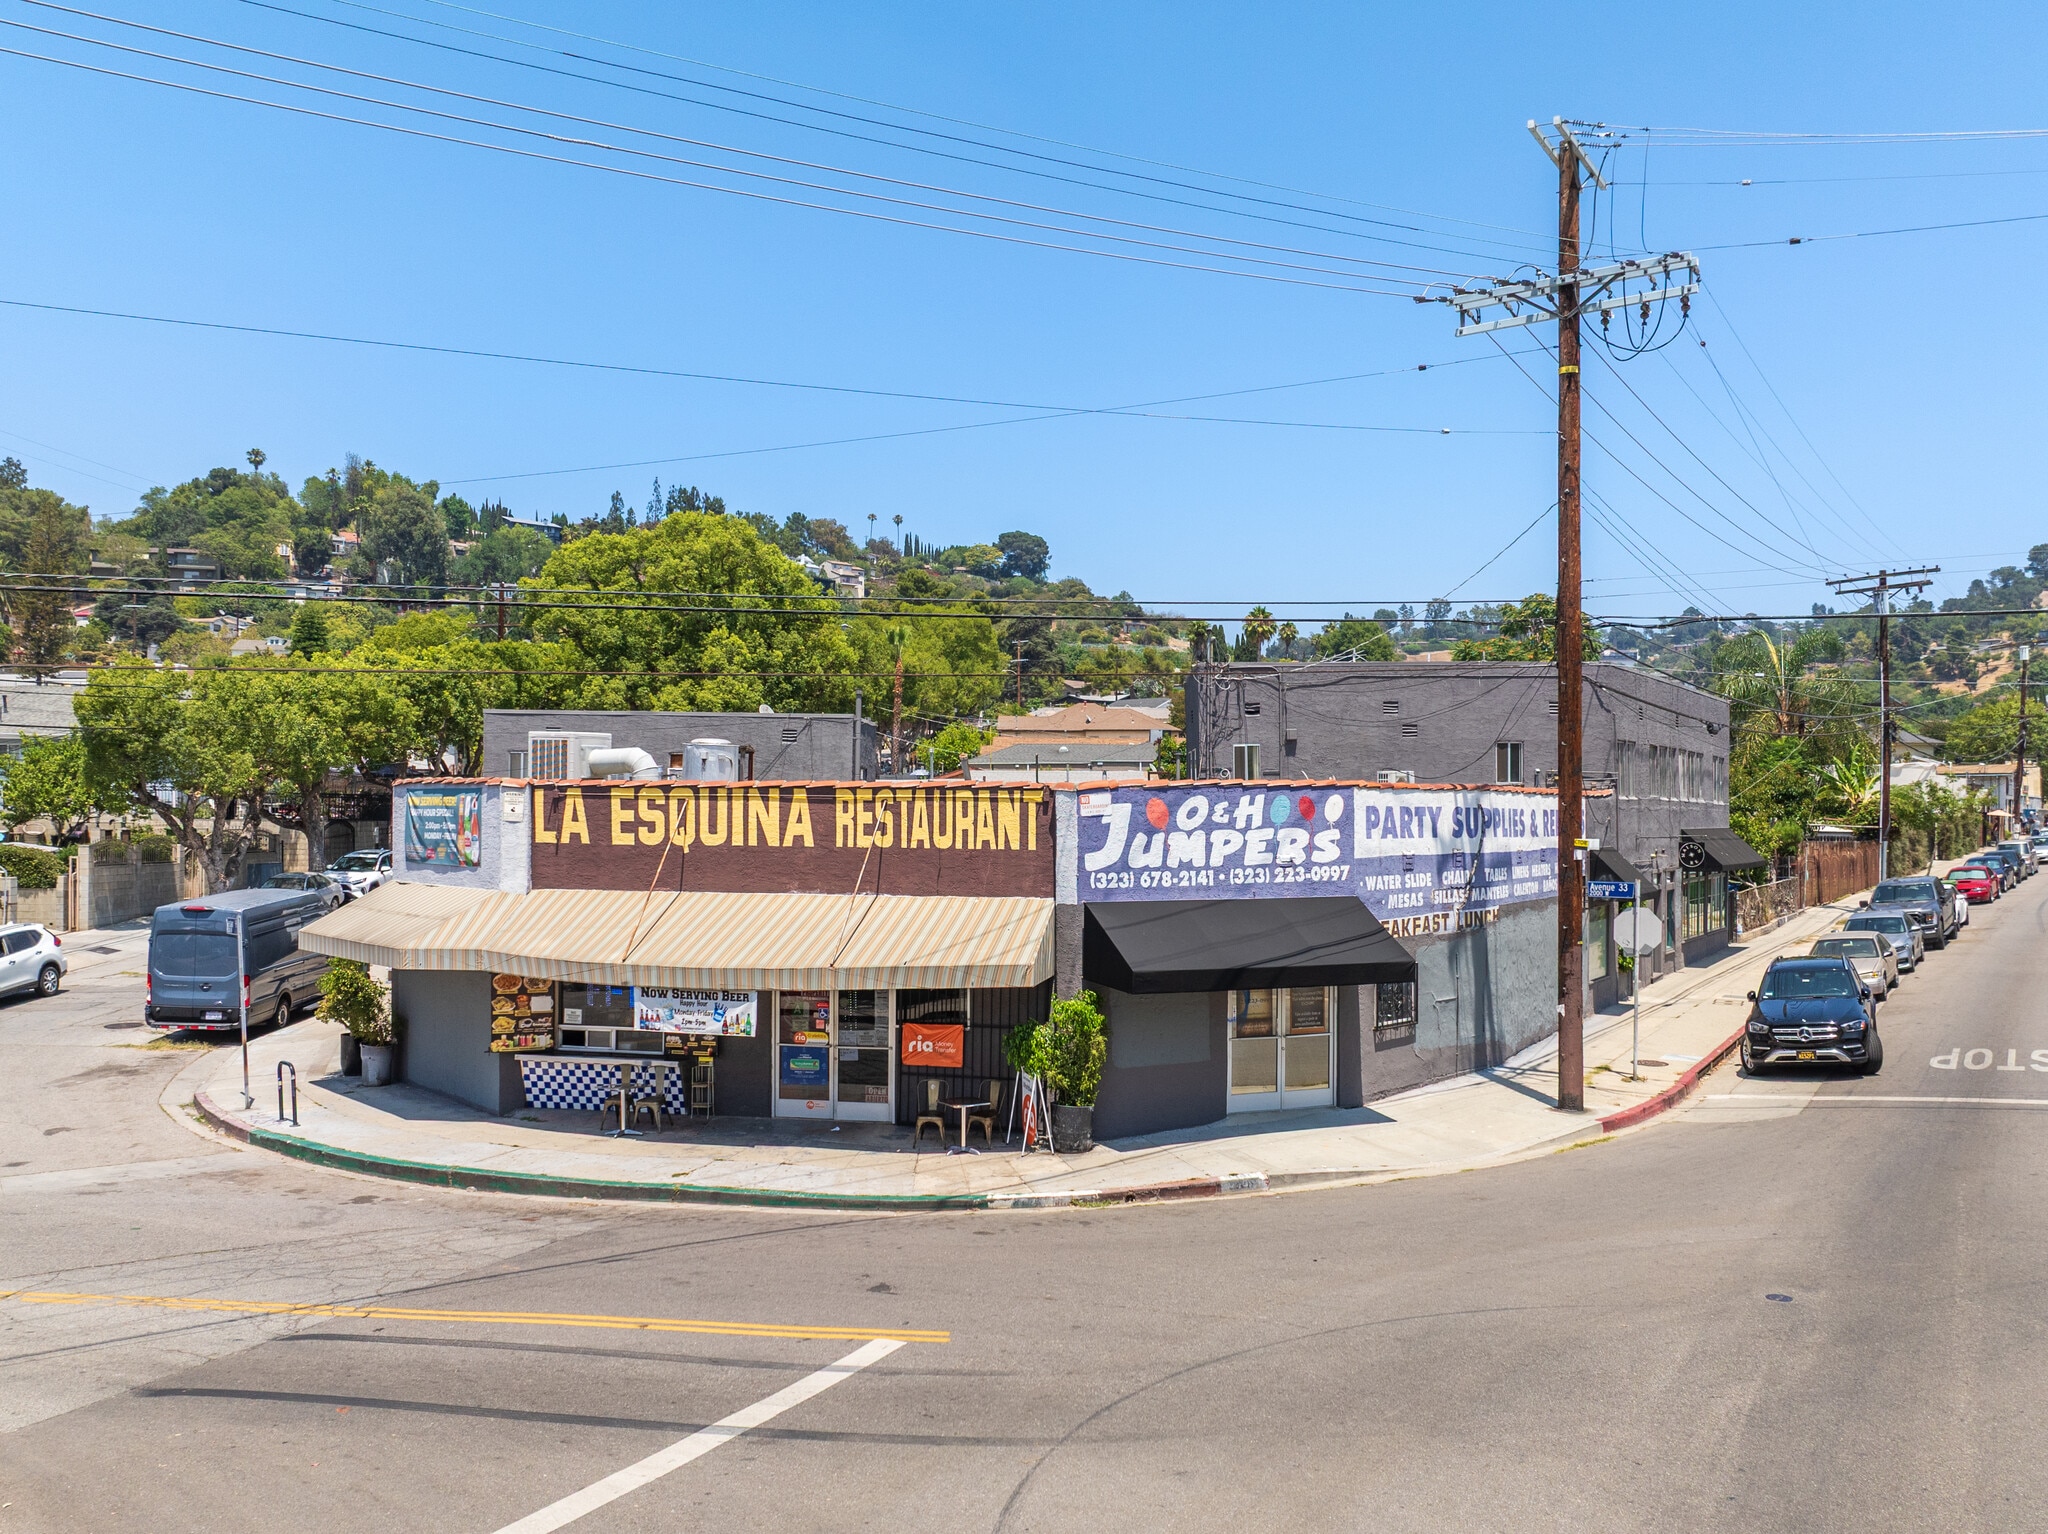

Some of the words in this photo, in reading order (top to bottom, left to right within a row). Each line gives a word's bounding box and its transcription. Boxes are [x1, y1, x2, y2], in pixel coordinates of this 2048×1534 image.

[420, 796, 443, 807] SERVING
[424, 808, 436, 817] HOUR
[534, 787, 590, 845] LA
[610, 787, 815, 854] ESQUINA
[835, 787, 1044, 851] RESTAURANT
[1365, 805, 1443, 840] PARTY
[1452, 806, 1525, 839] SUPPLIES
[1530, 809, 1539, 838] &
[424, 832, 442, 840] MONDAY
[1084, 803, 1341, 871] JUMPERS
[1090, 871, 1134, 889] (323)
[1140, 869, 1214, 888] 678-2141
[1230, 866, 1270, 885] (323)
[1273, 865, 1350, 884] 223-0997
[1365, 875, 1403, 892] WATER
[1405, 872, 1432, 889] SLIDE
[1484, 867, 1508, 882] TABLES
[1512, 865, 1529, 880] LINENS
[1531, 863, 1552, 878] HEATERS
[1589, 882, 1615, 892] Avenue
[1618, 883, 1628, 892] 33
[1387, 893, 1424, 909] MESAS
[1433, 889, 1464, 904] SILLAS
[1471, 884, 1509, 901] MANTELES
[1456, 906, 1501, 931] LUNCH
[641, 986, 668, 999] NOW
[672, 988, 718, 1001] SERVING
[722, 990, 750, 1003] BEER
[674, 1008, 695, 1017] Monday
[698, 1009, 714, 1018] Friday
[681, 1017, 707, 1026] 2pm-5pm
[794, 1033, 806, 1041] ria
[908, 1034, 934, 1053] ria
[934, 1046, 957, 1054] Transfer
[1929, 1047, 2048, 1072] STOP
